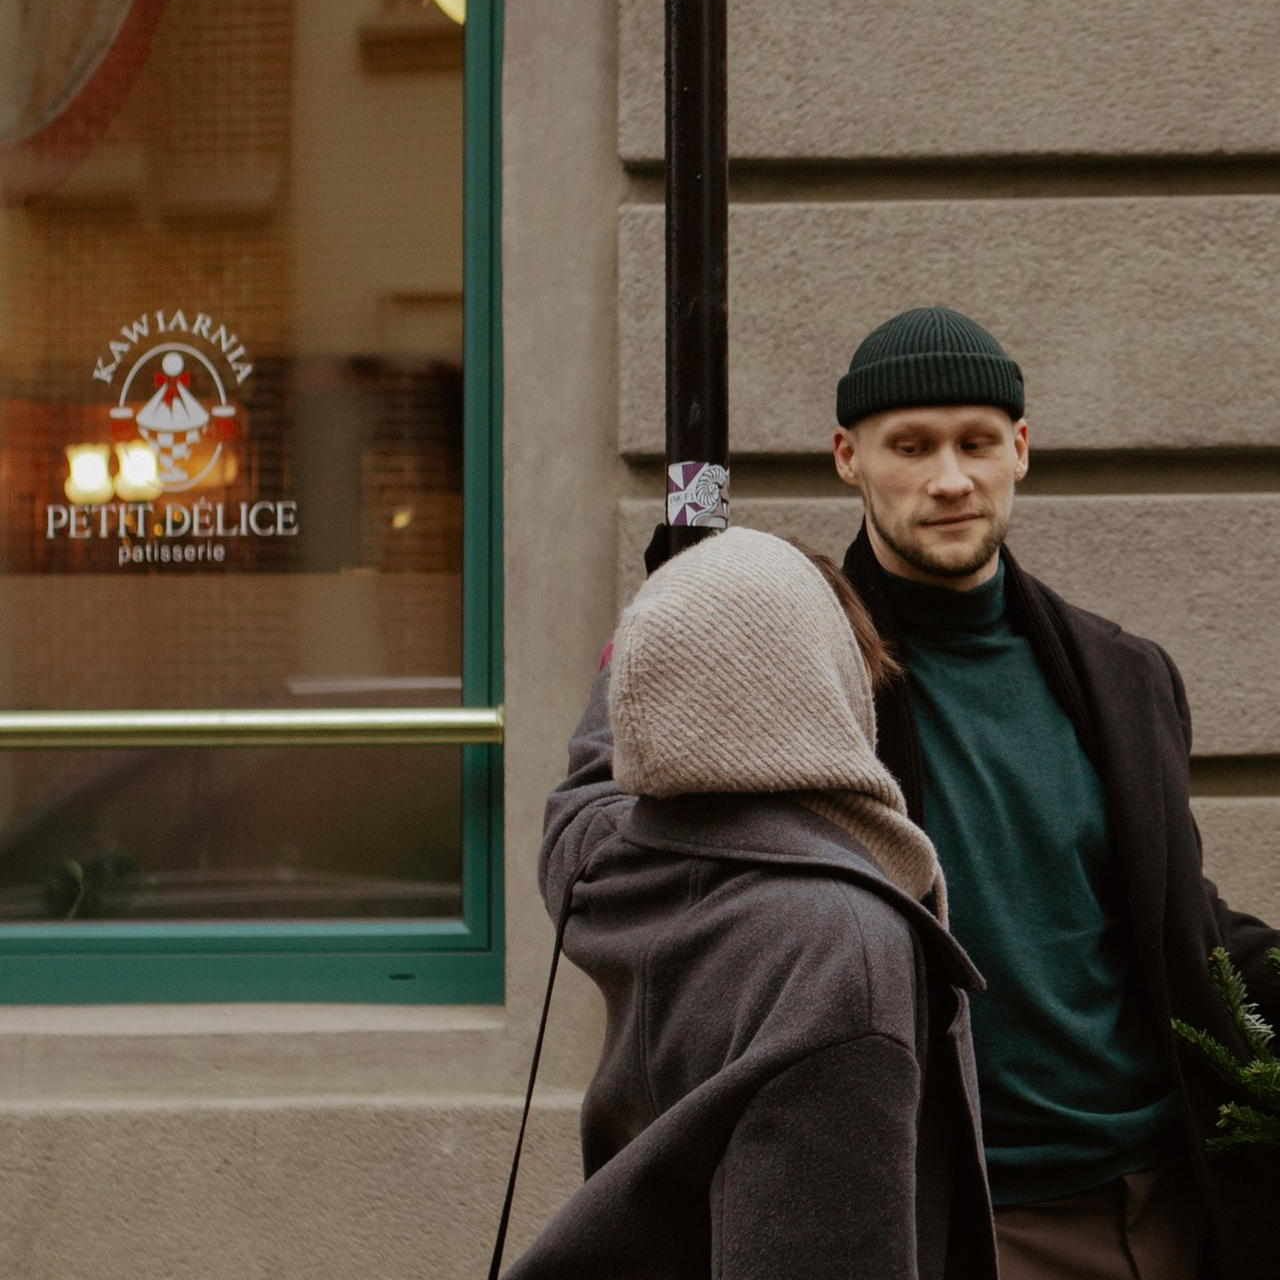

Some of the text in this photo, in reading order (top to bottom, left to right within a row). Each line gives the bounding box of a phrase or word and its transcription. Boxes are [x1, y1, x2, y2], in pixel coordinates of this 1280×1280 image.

[93, 308, 254, 385] KAWIARNIA
[46, 496, 299, 539] PETIT DÉLICE
[118, 540, 226, 566] patisserie
